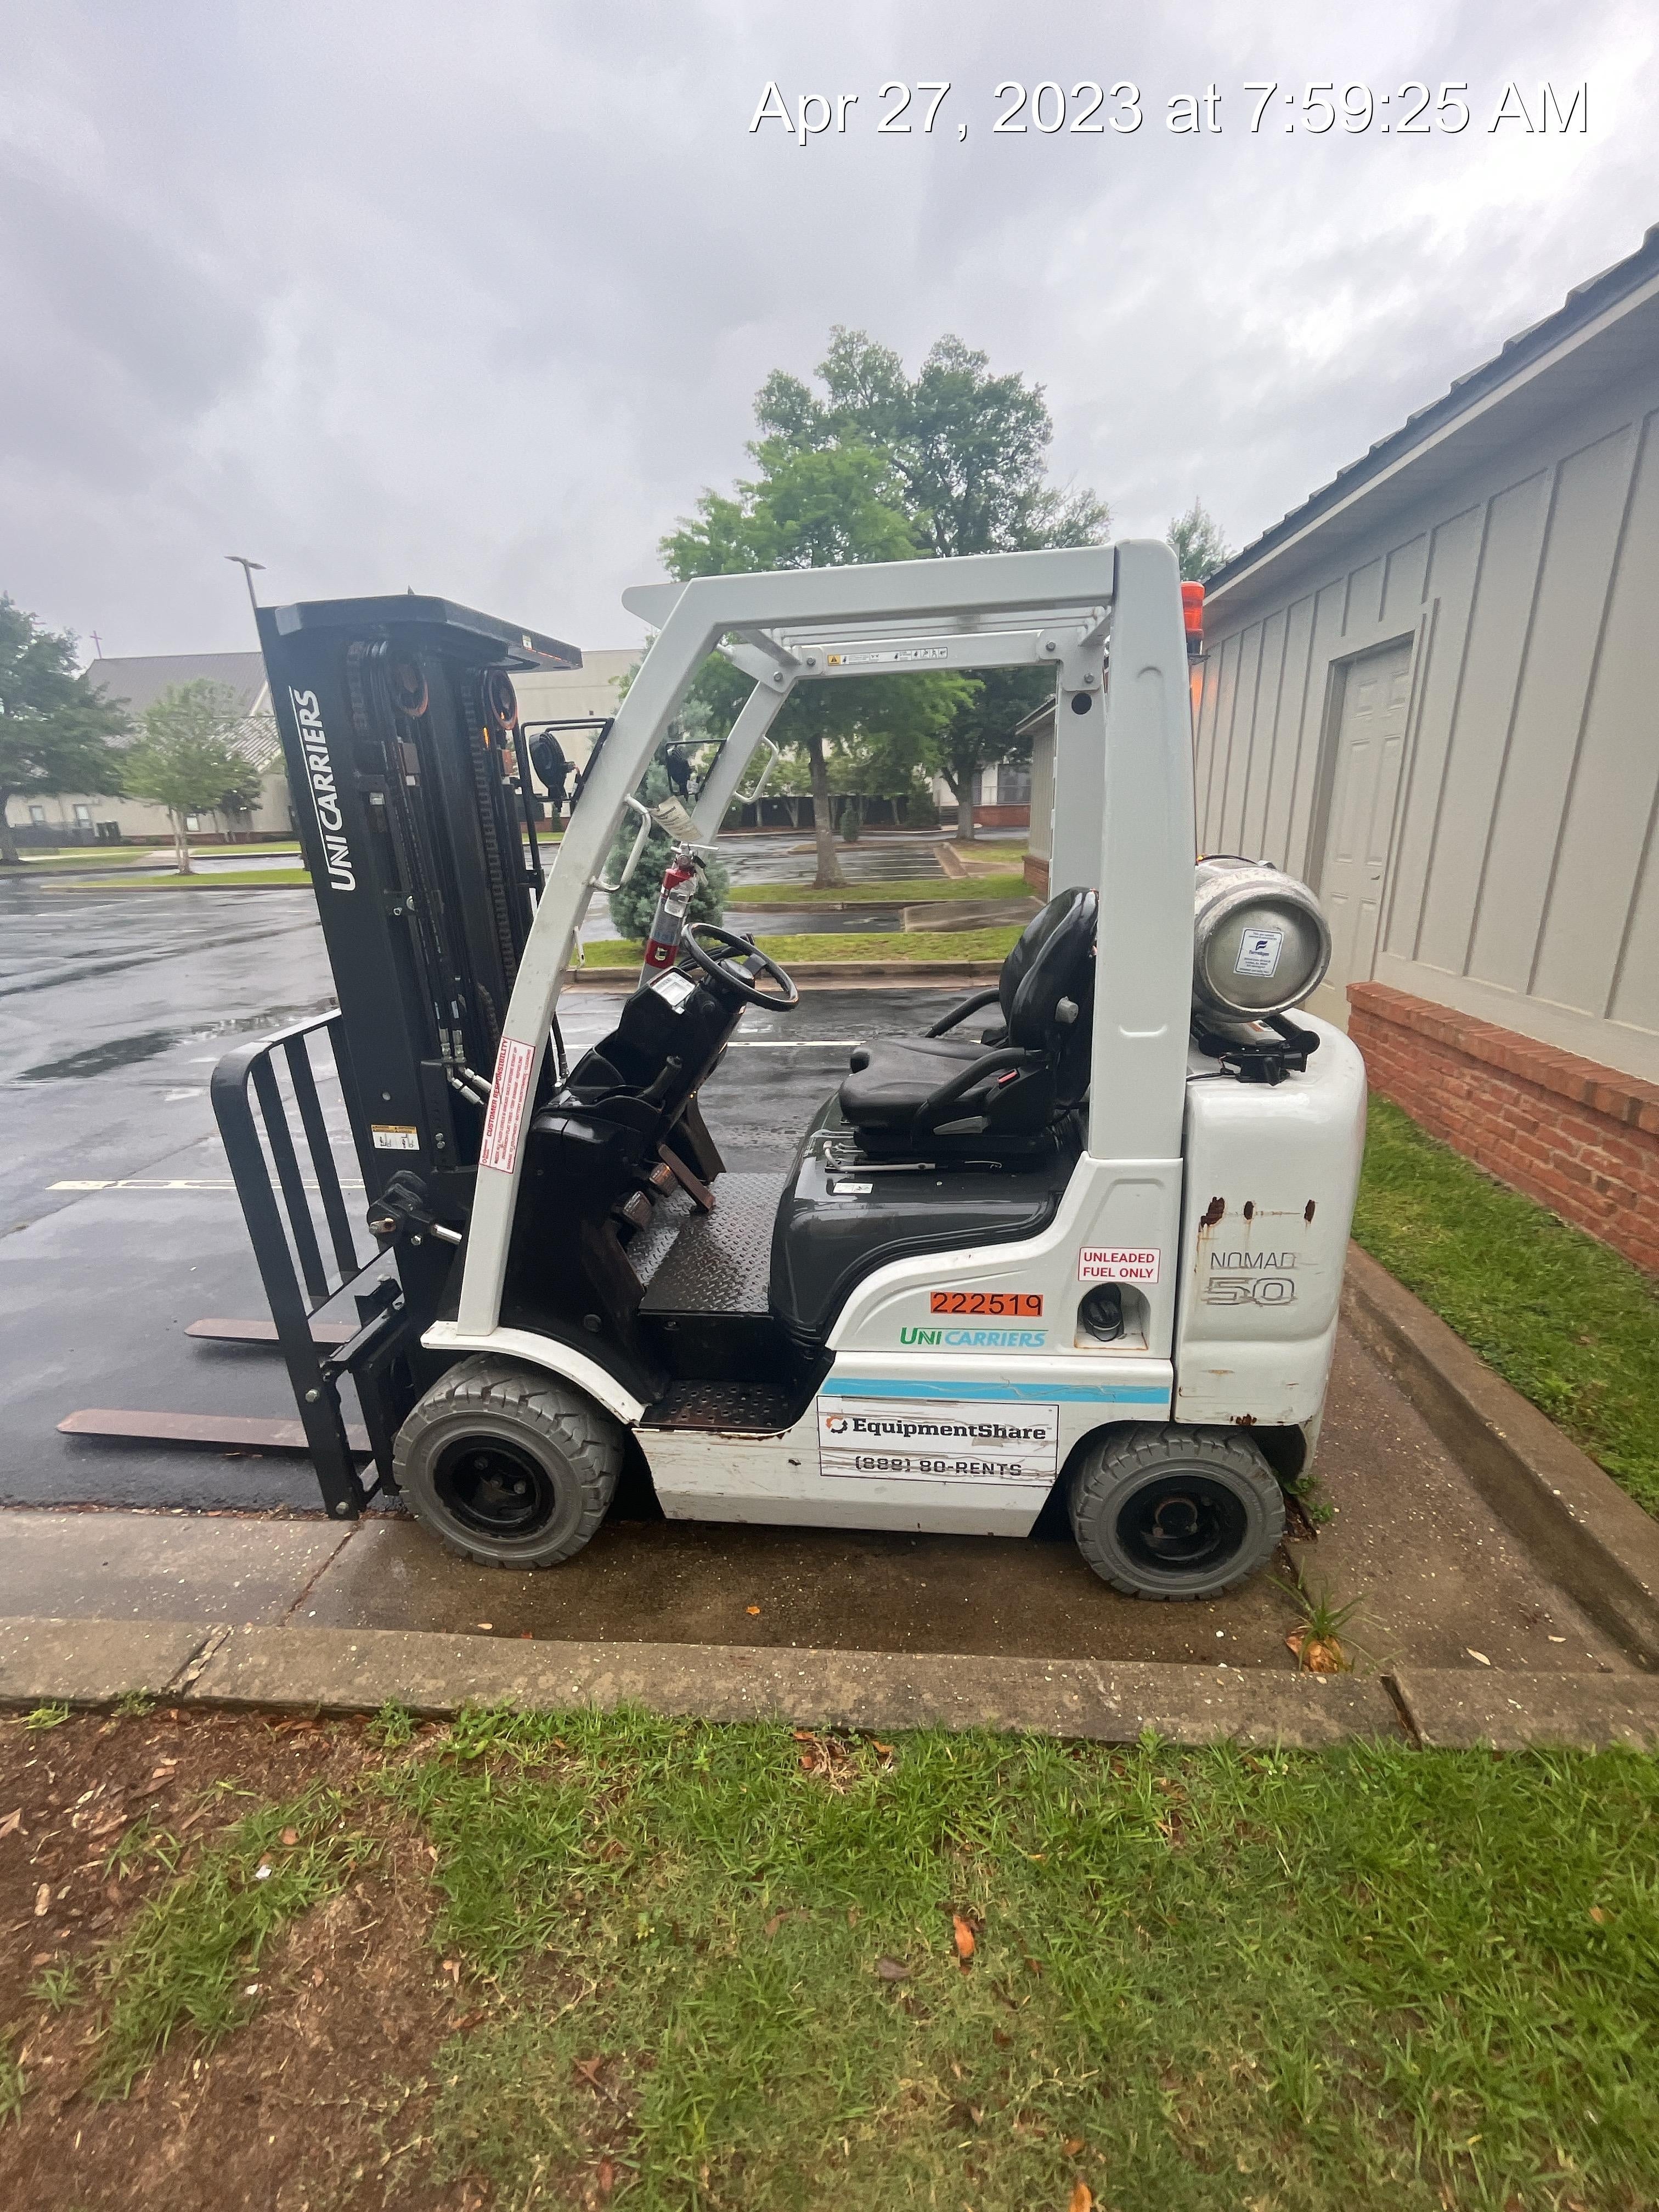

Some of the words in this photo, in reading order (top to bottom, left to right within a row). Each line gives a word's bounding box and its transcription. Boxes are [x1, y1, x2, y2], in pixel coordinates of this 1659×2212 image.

[486, 1098, 498, 1137] CUSTOMER
[493, 1039, 508, 1098] RESPONSIBILITY
[1084, 1252, 1155, 1263] UNLEADED
[1210, 1252, 1296, 1269] NOMAD
[1083, 1267, 1116, 1277] FUEL
[1119, 1268, 1154, 1278] ONLY
[1206, 1277, 1295, 1306] 50
[933, 1292, 1042, 1316] 222519
[852, 1418, 1046, 1440] EquipmentShare
[919, 1460, 1022, 1476] 80-RENTS
